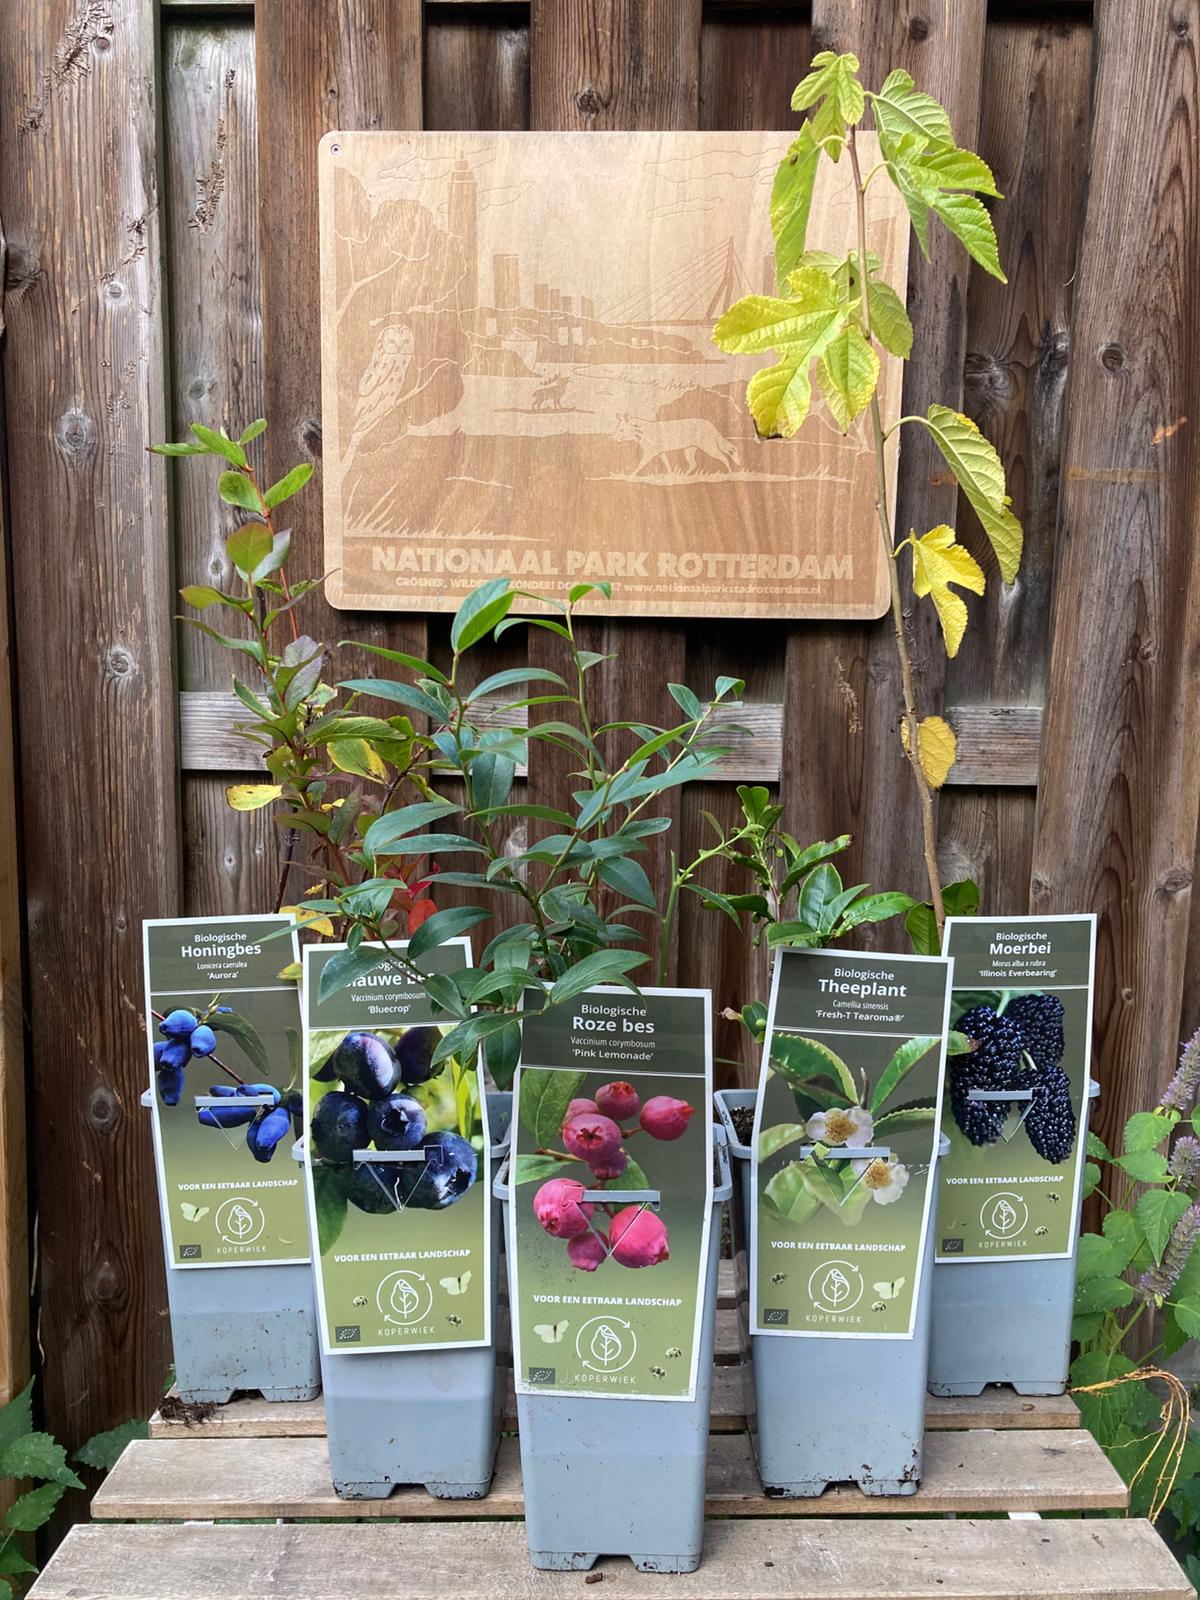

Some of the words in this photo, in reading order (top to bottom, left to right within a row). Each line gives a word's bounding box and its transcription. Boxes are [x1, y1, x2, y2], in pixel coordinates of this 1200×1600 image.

[372, 546, 558, 575] NATIONAAL
[567, 550, 649, 577] PARK
[657, 552, 854, 580] ROTTERDAM
[194, 932, 247, 943] Biologische
[995, 932, 1048, 942] Biologische
[181, 943, 262, 959] Honingbes
[989, 942, 1051, 955] Moerbei
[197, 961, 221, 970] Lonicera
[223, 961, 248, 969] caerulea
[834, 968, 895, 981] Biologische
[818, 979, 907, 998] Theeplant
[351, 993, 384, 1002] Vaccinium
[385, 992, 427, 1002] corymbosum
[581, 1004, 647, 1017] Biologische
[832, 1000, 861, 1009] Camellia
[862, 1001, 889, 1010] sinensis
[572, 1016, 617, 1032] Roze
[623, 1018, 655, 1034] bes
[570, 1036, 607, 1046] Vaccinium
[608, 1038, 656, 1049] corymbosum
[252, 1179, 298, 1188] LANDSCHAP
[985, 1176, 1018, 1184] EETBAAR
[1019, 1175, 1064, 1183] LANDSCHAP
[216, 1246, 267, 1254] KOPERWIEK
[771, 1241, 796, 1249] VOOR
[797, 1241, 814, 1250] EEN
[815, 1242, 853, 1251] EETBAAR
[854, 1243, 906, 1252] LANDSCHAP
[978, 1240, 1028, 1249] KOPERWIEK
[334, 1254, 360, 1262] VOOR
[360, 1254, 377, 1262] EEN
[379, 1252, 417, 1261] EETBAAR
[418, 1249, 471, 1259] LANDSCHAP
[533, 1294, 561, 1304] VOOR
[562, 1295, 580, 1304] EEN
[582, 1296, 623, 1305] EETBAAR
[625, 1297, 682, 1307] LANDSCHAP
[805, 1314, 863, 1323] KOPERWIEK
[378, 1326, 435, 1336] KOPERWIEK
[574, 1374, 636, 1384] KOPERWIEK
